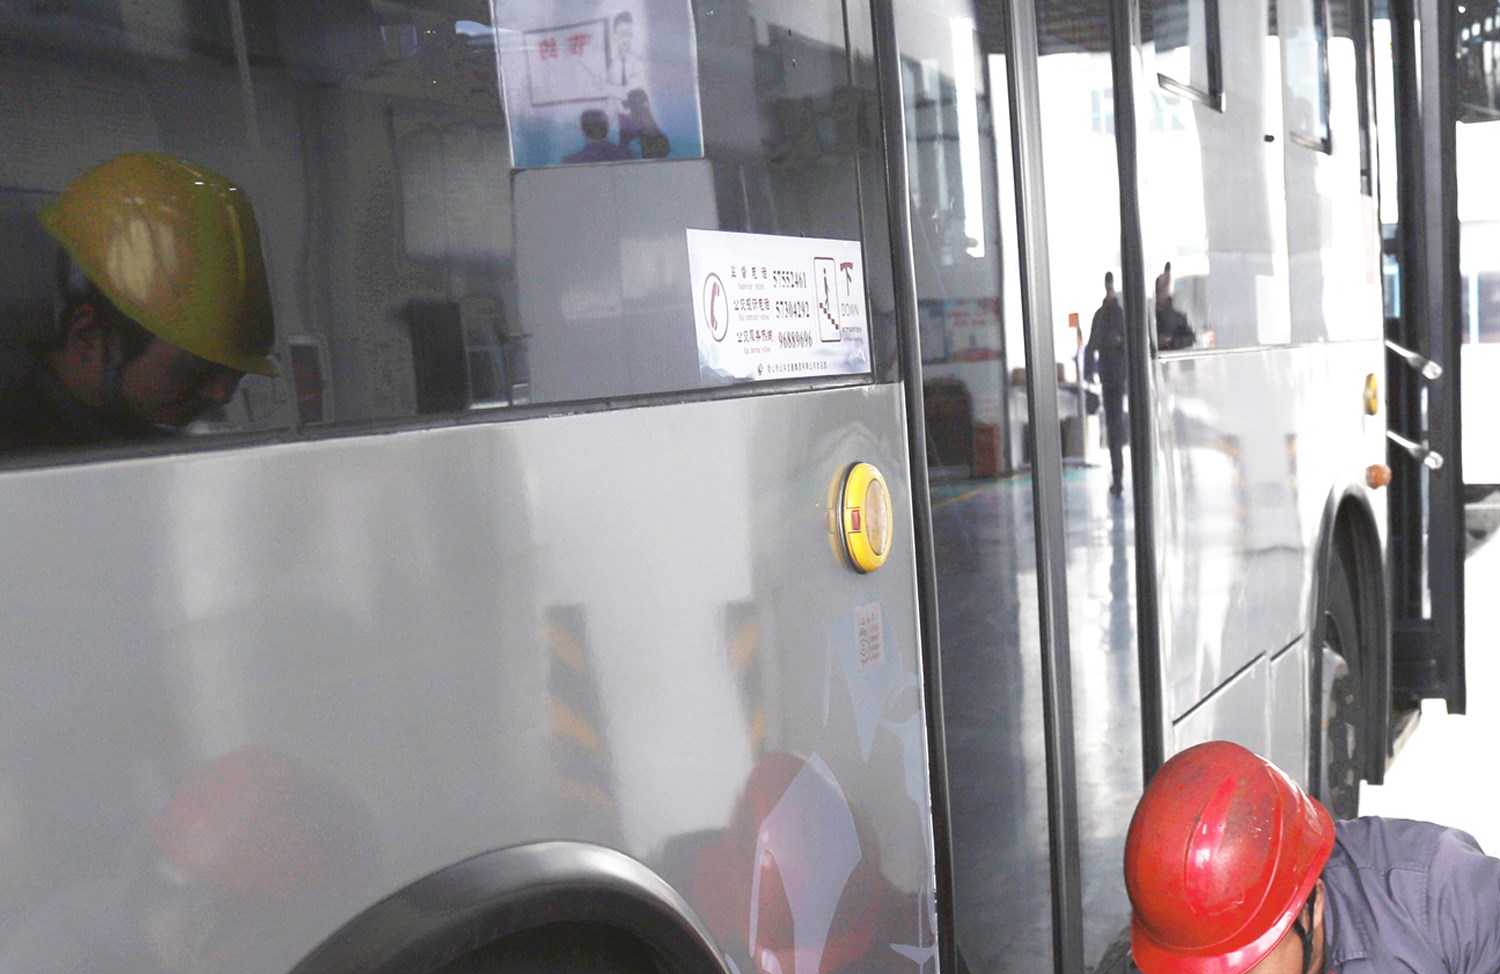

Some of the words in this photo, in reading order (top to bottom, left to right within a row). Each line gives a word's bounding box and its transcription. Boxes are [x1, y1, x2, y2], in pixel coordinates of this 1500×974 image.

[773, 270, 807, 288] 57552461
[775, 301, 810, 318] 57304292
[778, 331, 813, 349] 96889696
